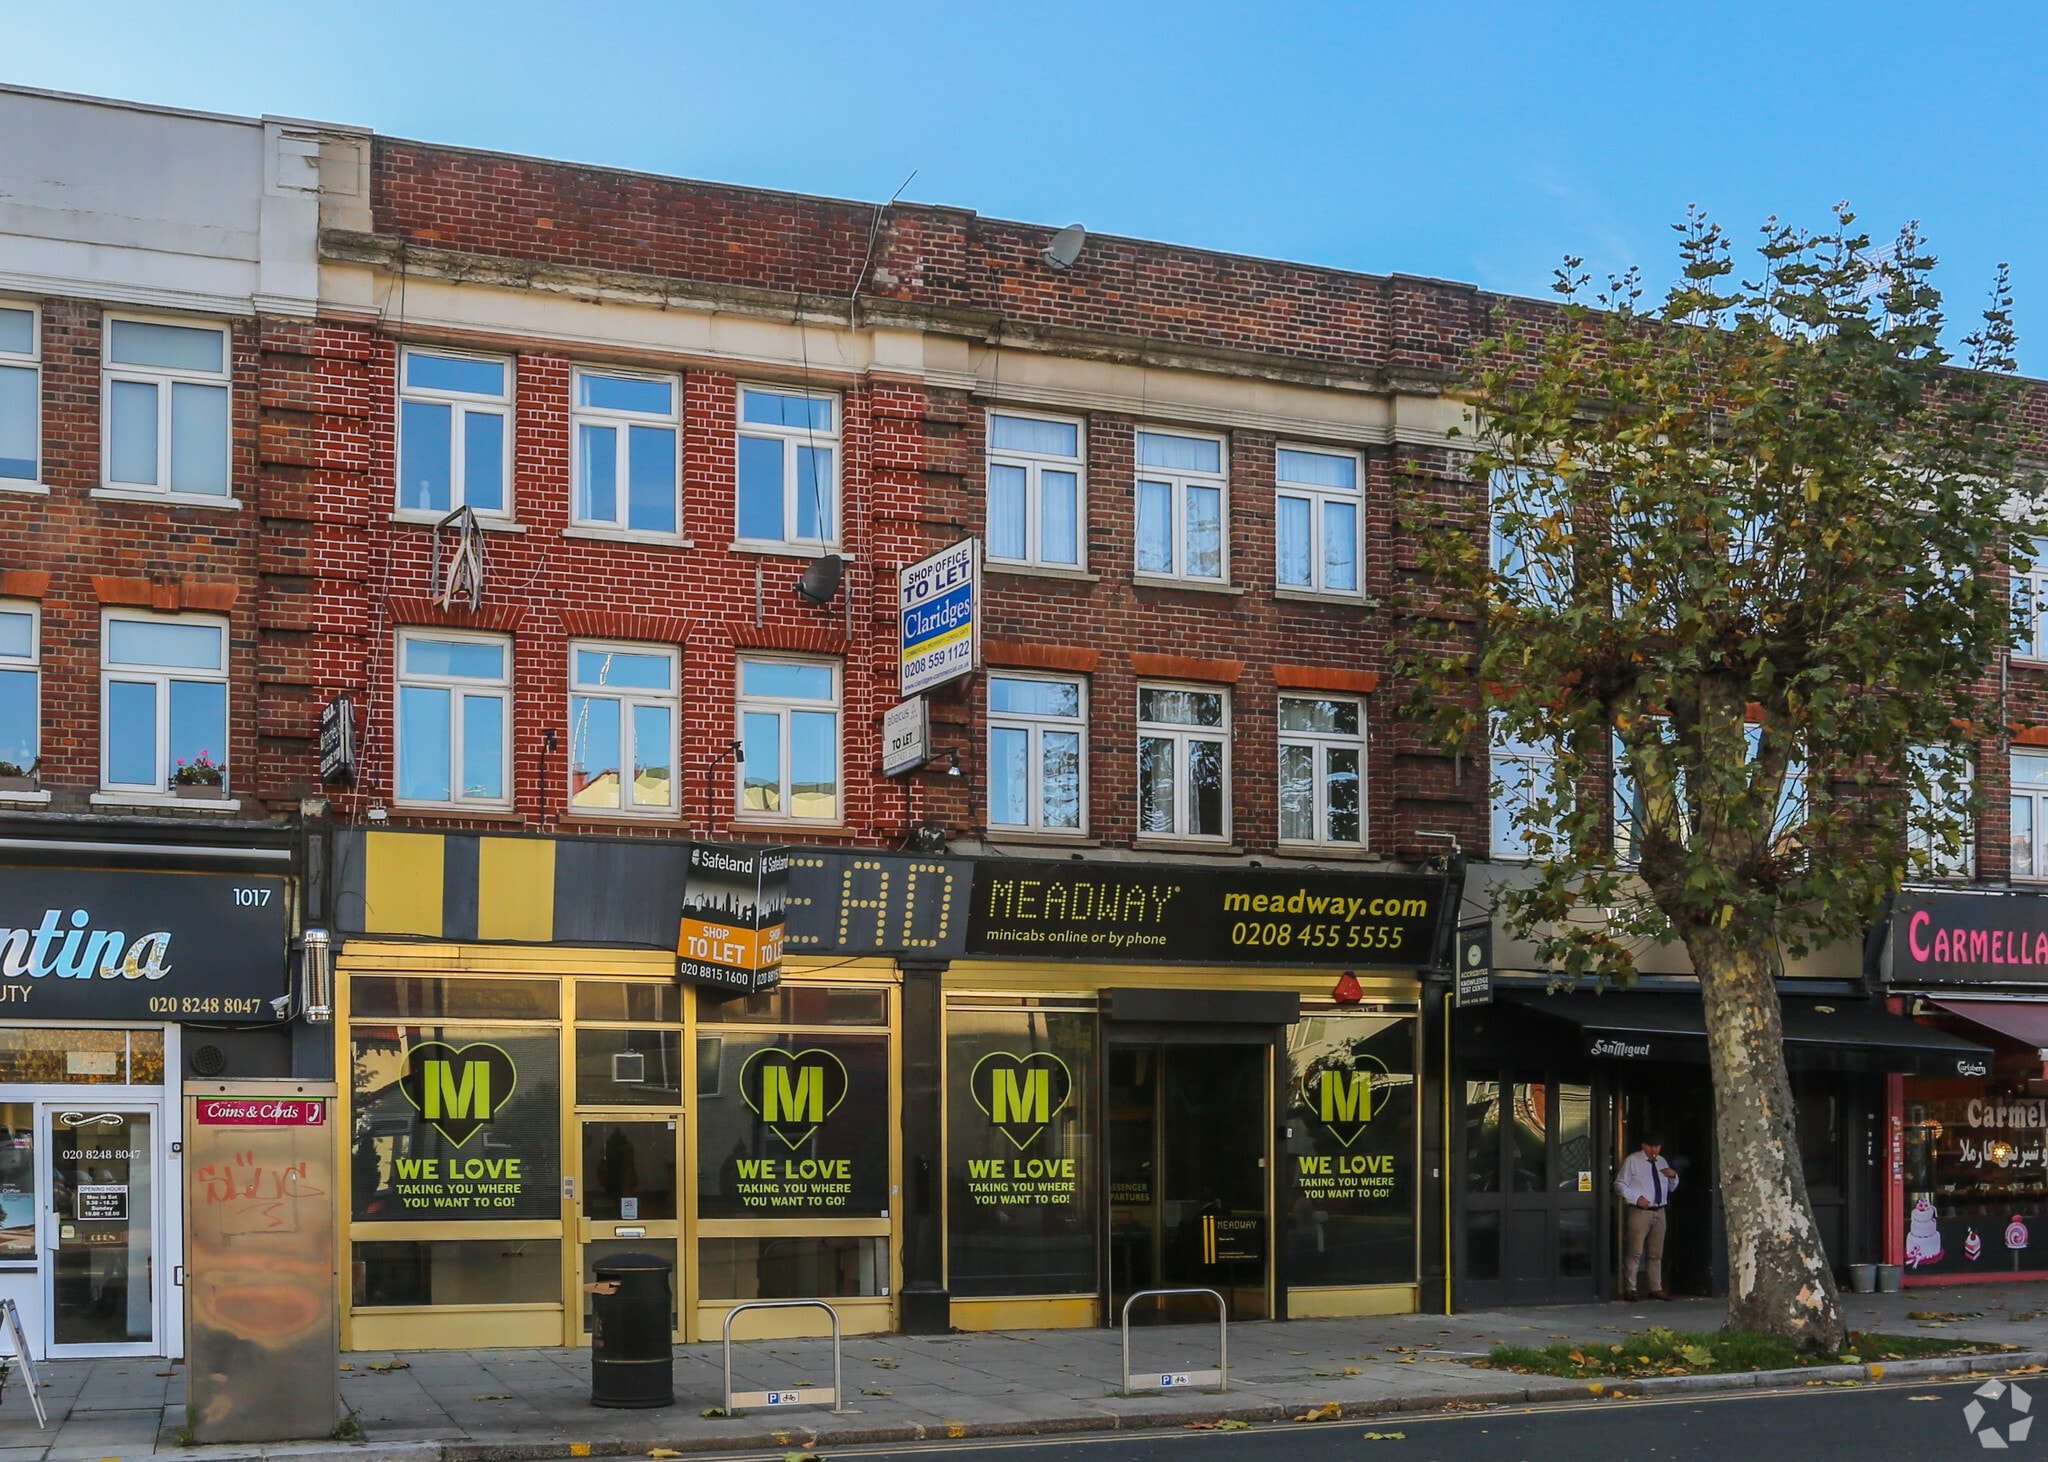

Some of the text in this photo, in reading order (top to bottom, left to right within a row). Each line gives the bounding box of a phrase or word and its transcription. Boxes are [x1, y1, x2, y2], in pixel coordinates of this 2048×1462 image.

[903, 559, 970, 603] TO LET
[905, 598, 970, 638] Claridges
[904, 640, 970, 678] 0208 559 1122
[892, 732, 913, 751] TO LET
[701, 850, 754, 874] Safeland
[768, 853, 790, 873] Safeland
[233, 888, 272, 907] 1017
[988, 879, 1174, 923] MEADWAY
[1223, 889, 1428, 923] meadway.com
[702, 925, 730, 940] SHOP
[769, 928, 781, 941] SHOP
[986, 929, 1167, 947] minicabs online or by phone
[1231, 922, 1404, 949] 0208 455 5555
[1908, 910, 2048, 965] CARMELLA
[687, 935, 746, 964] TO LET
[760, 944, 773, 965] TO
[681, 962, 749, 985] 020 8815 1600
[756, 972, 767, 985] 020
[1460, 968, 1489, 979] ACCREDITED
[1460, 976, 1489, 987] KNOWLEDGE
[150, 997, 261, 1014] 020 8248 8047
[424, 1060, 490, 1120] M
[763, 1065, 824, 1122] M
[992, 1068, 1049, 1123] M
[1321, 1070, 1372, 1122] M
[207, 1102, 299, 1119] Coins & Cards
[1967, 1098, 2047, 1129] Carmel
[62, 1150, 142, 1160] 020 8248 8047
[1298, 1155, 1394, 1175] WE LOVE
[396, 1158, 522, 1180] WE LOVE
[736, 1159, 851, 1179] WE LOVE
[967, 1159, 1076, 1179] WE LOVE
[396, 1183, 522, 1195] TAKING YOU WHERE
[736, 1183, 852, 1194] TAKING YOU WHERE
[968, 1182, 1076, 1192] TAKING YOU WHERE
[1299, 1177, 1395, 1187] TAKING YOU WHERE
[402, 1197, 516, 1208] YOU WANT TO GO!
[742, 1196, 846, 1207] YOU WANT TO GO!
[974, 1194, 1070, 1205] YOU WANT TO GO!
[1304, 1189, 1390, 1199] YOU WANT TO GO!
[1217, 1220, 1257, 1230] MEADWAY
